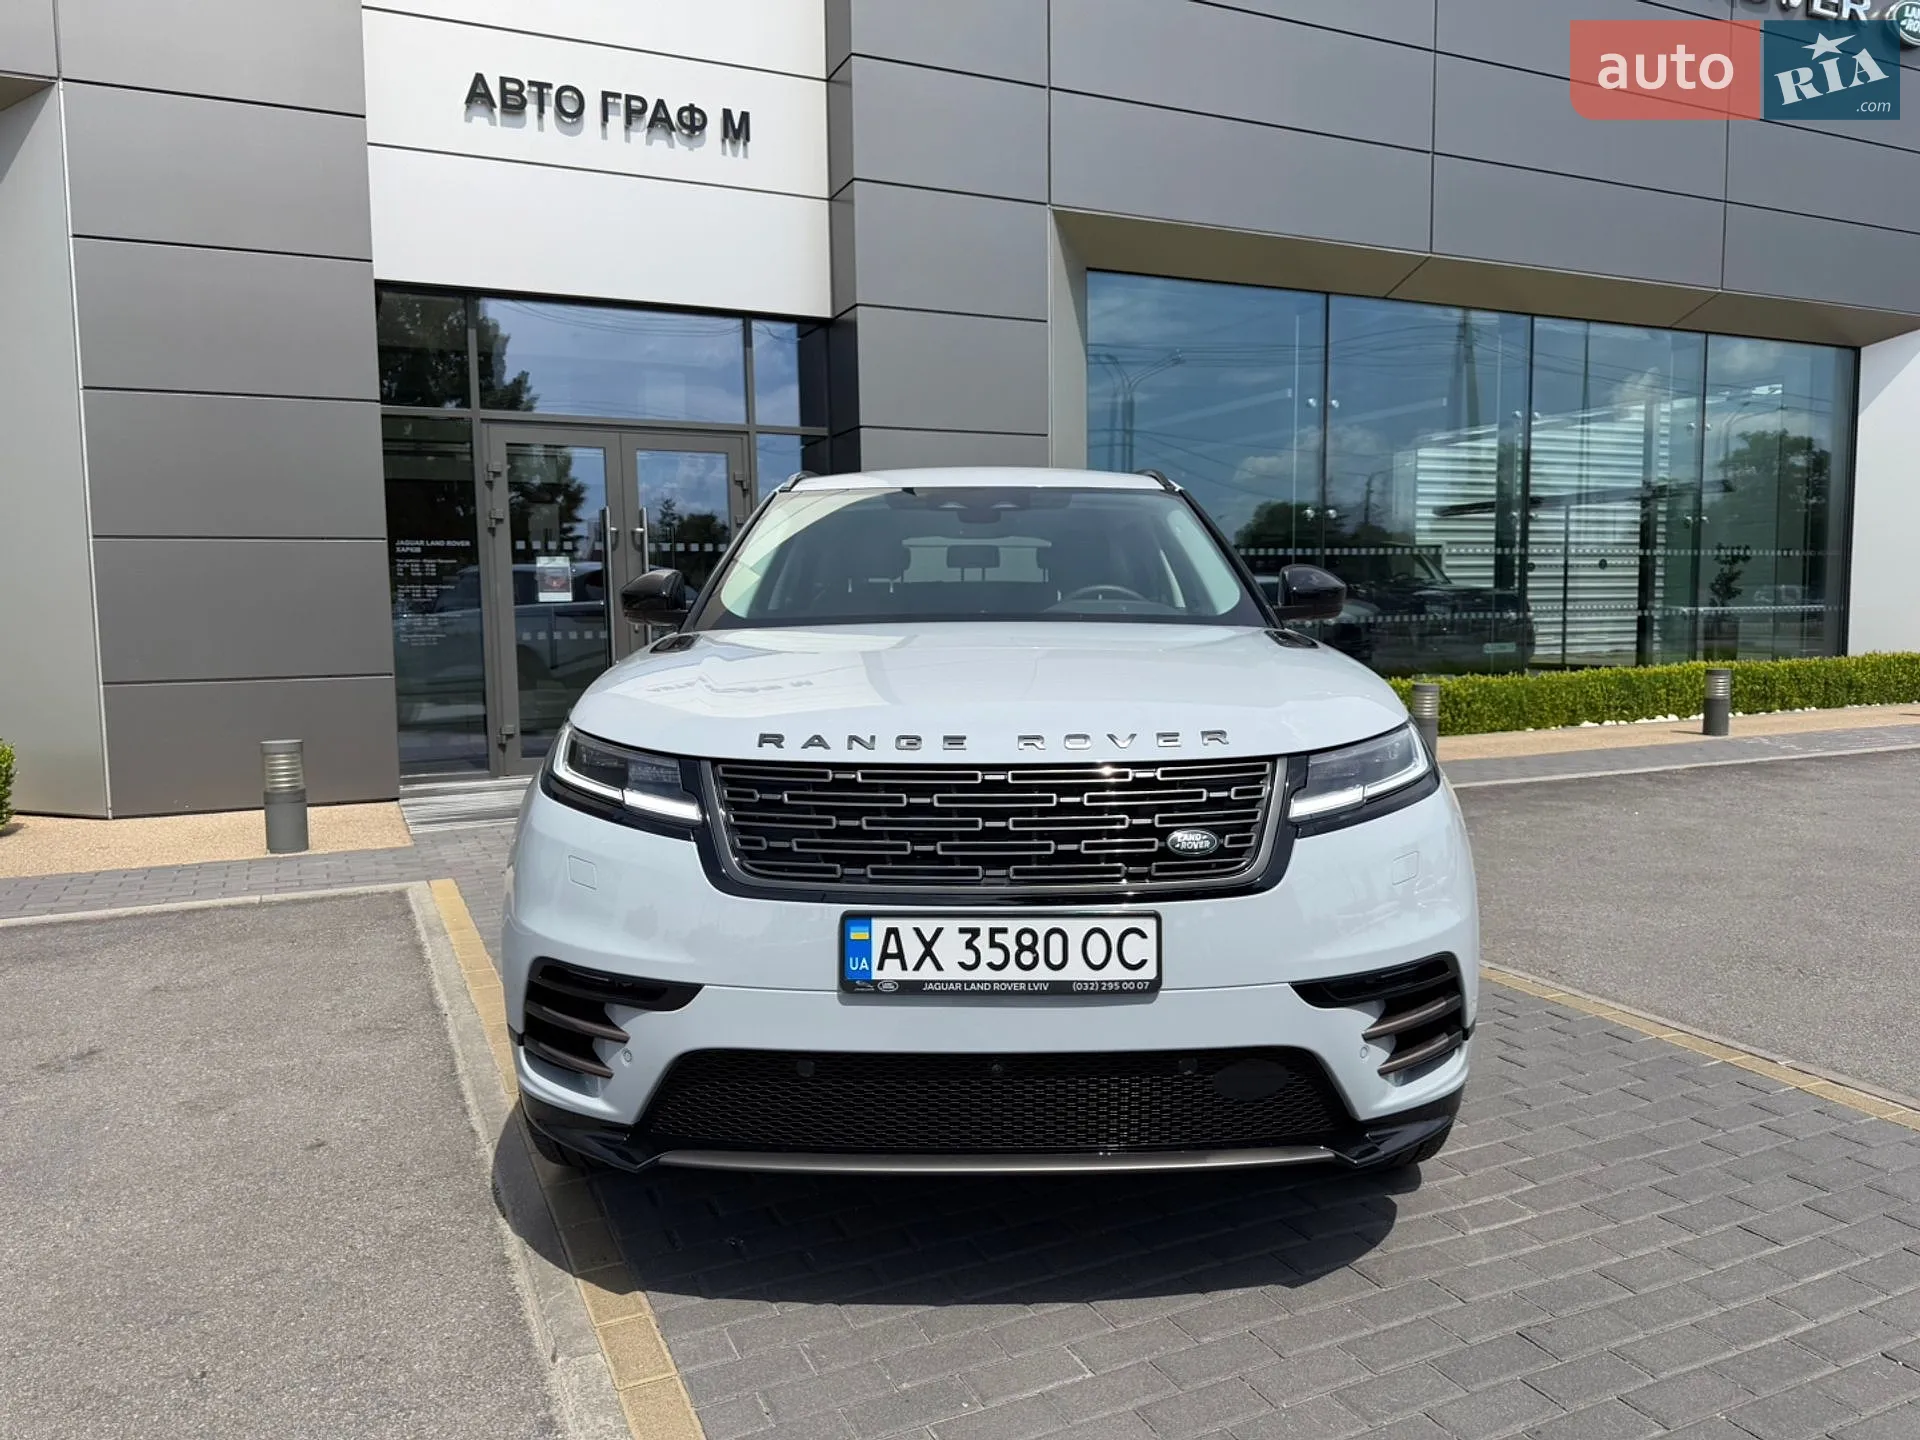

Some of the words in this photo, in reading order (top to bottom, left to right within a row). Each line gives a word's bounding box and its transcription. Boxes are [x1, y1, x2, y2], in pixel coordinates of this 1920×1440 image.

[464, 72, 585, 121] АВТО
[601, 89, 708, 135] ГРАФ
[722, 107, 751, 143] М
[757, 732, 967, 752] RANGE
[1017, 729, 1229, 751] ROVER
[1178, 833, 1202, 842] LAND
[1181, 840, 1210, 849] ROVER
[876, 926, 945, 972] AX
[957, 926, 1069, 972] 3580
[1081, 926, 1149, 972] OC
[849, 957, 869, 972] UA
[922, 982, 962, 991] JAGUAR
[964, 982, 991, 991] LAND
[993, 982, 1026, 991] ROVER
[1028, 982, 1049, 991] LVIV
[1072, 982, 1099, 992] (032)
[1101, 981, 1120, 991] 295
[1122, 981, 1135, 991] 00
[1136, 981, 1150, 991] 07
